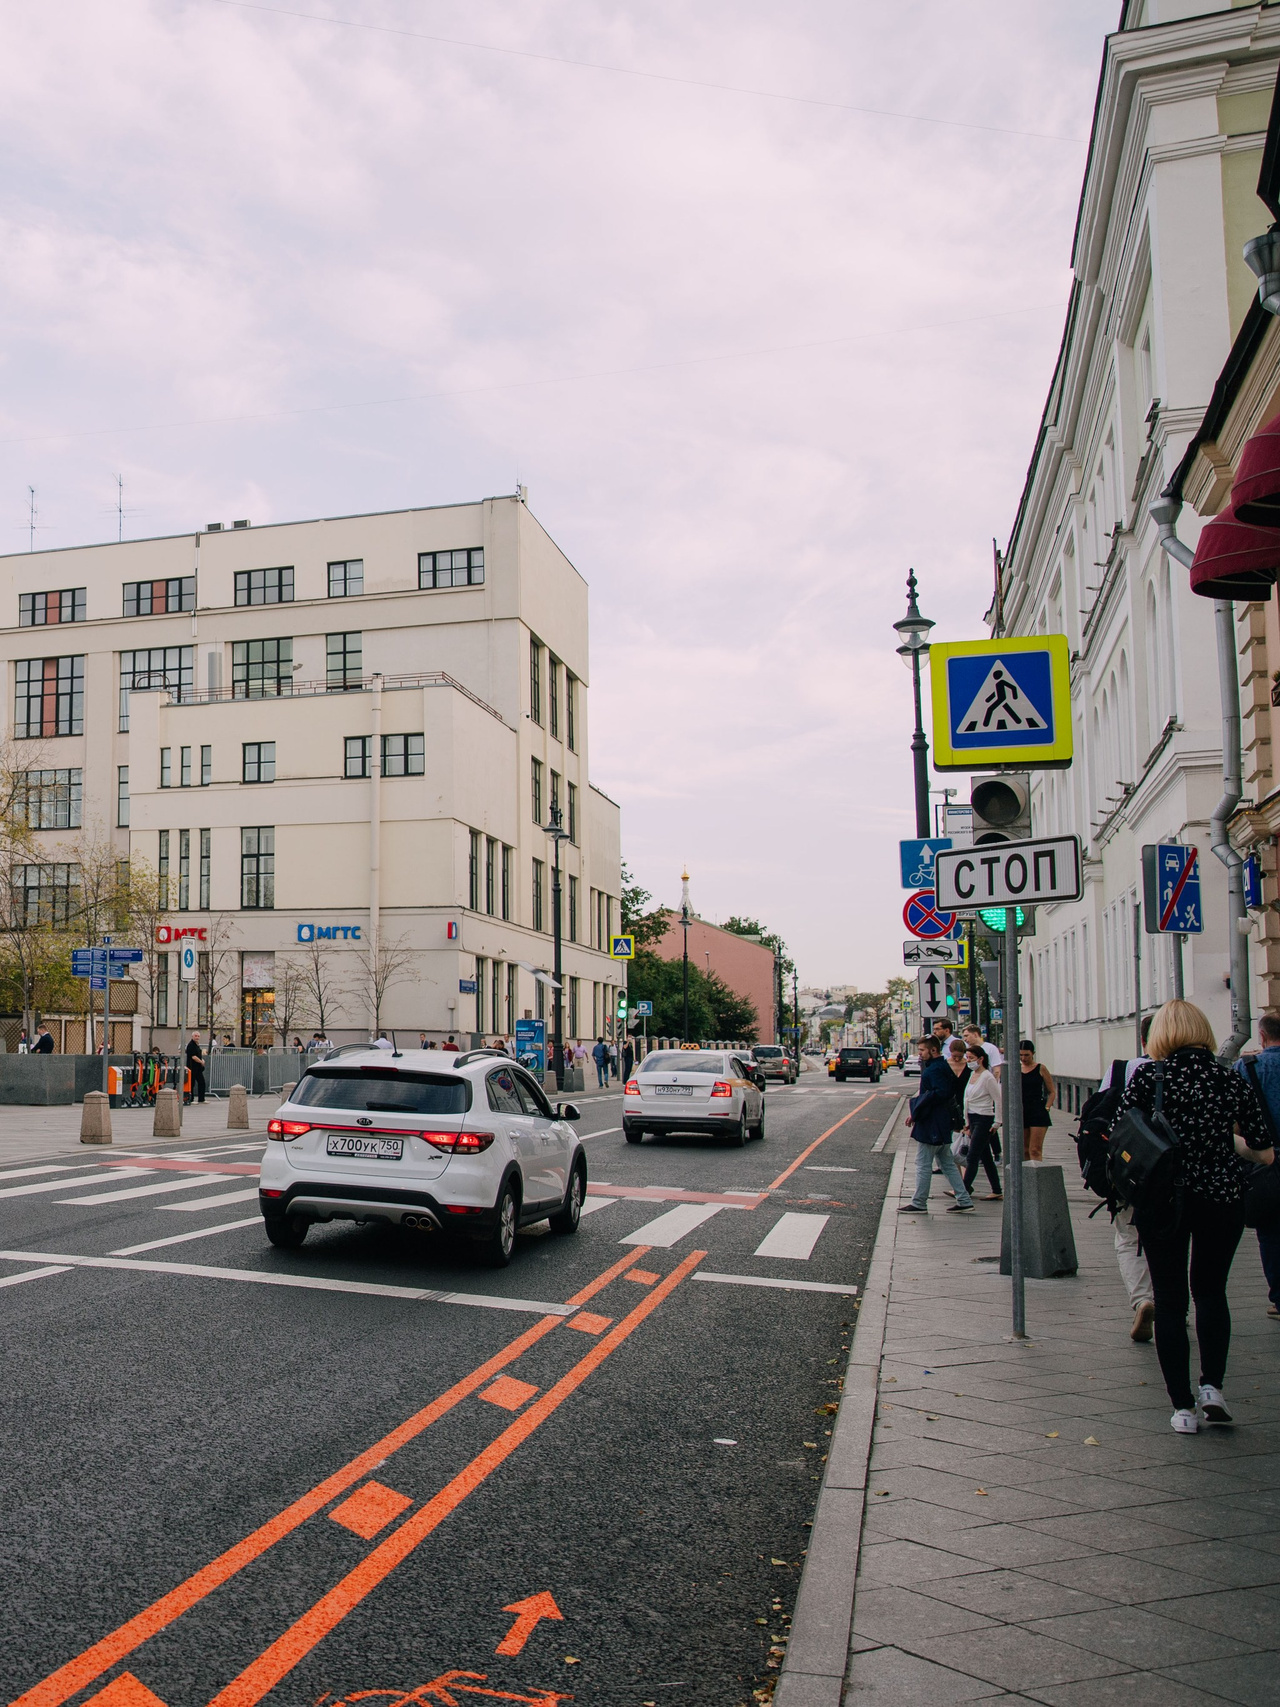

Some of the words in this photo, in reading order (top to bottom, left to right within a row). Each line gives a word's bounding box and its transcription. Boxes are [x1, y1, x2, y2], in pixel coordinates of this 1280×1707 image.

[955, 850, 1057, 899] СТОП
[174, 927, 207, 940] МТС
[317, 926, 361, 940] МГТС
[381, 1141, 398, 1151] 750
